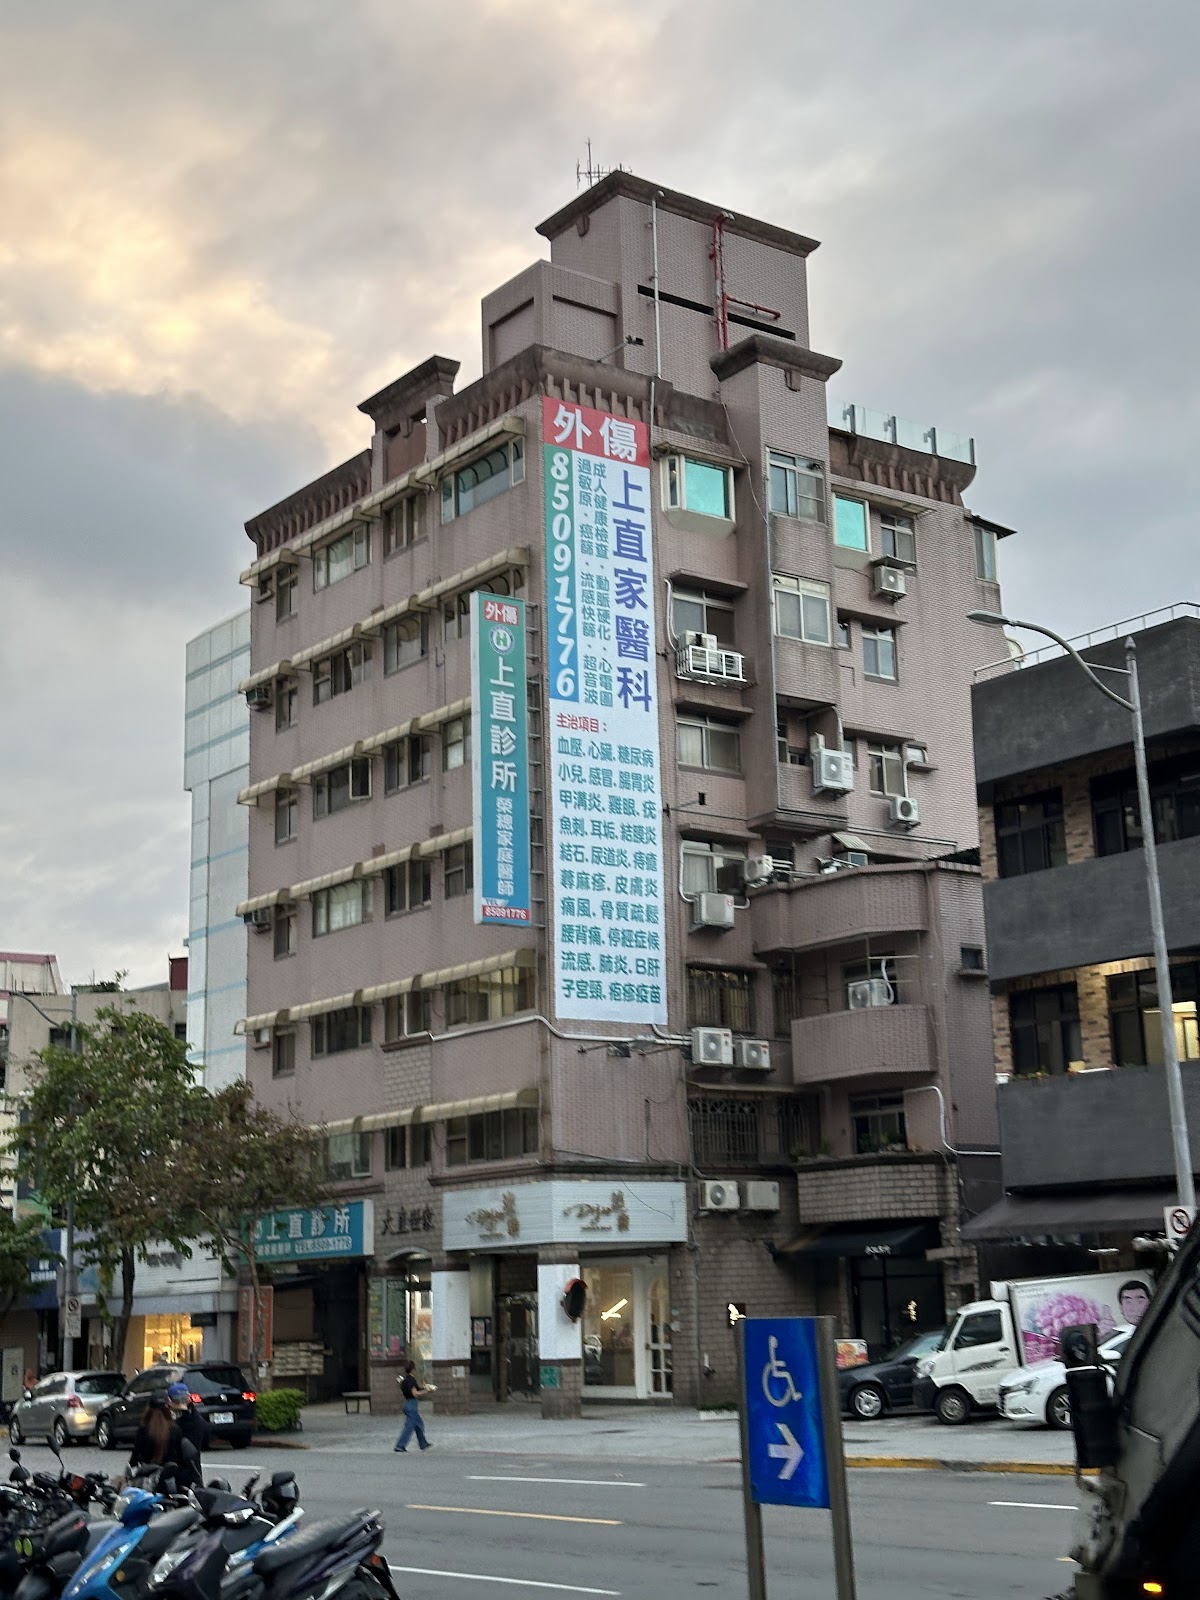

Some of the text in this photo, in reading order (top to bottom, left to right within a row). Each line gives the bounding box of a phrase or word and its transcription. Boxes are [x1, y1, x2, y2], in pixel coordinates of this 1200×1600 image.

[553, 404, 638, 463] 外傷
[485, 601, 518, 626] 外傷
[550, 451, 576, 697] 85091776
[611, 470, 652, 712] 上直家醫科
[489, 656, 518, 792] 上直診所
[266, 1207, 350, 1240] 上直診所
